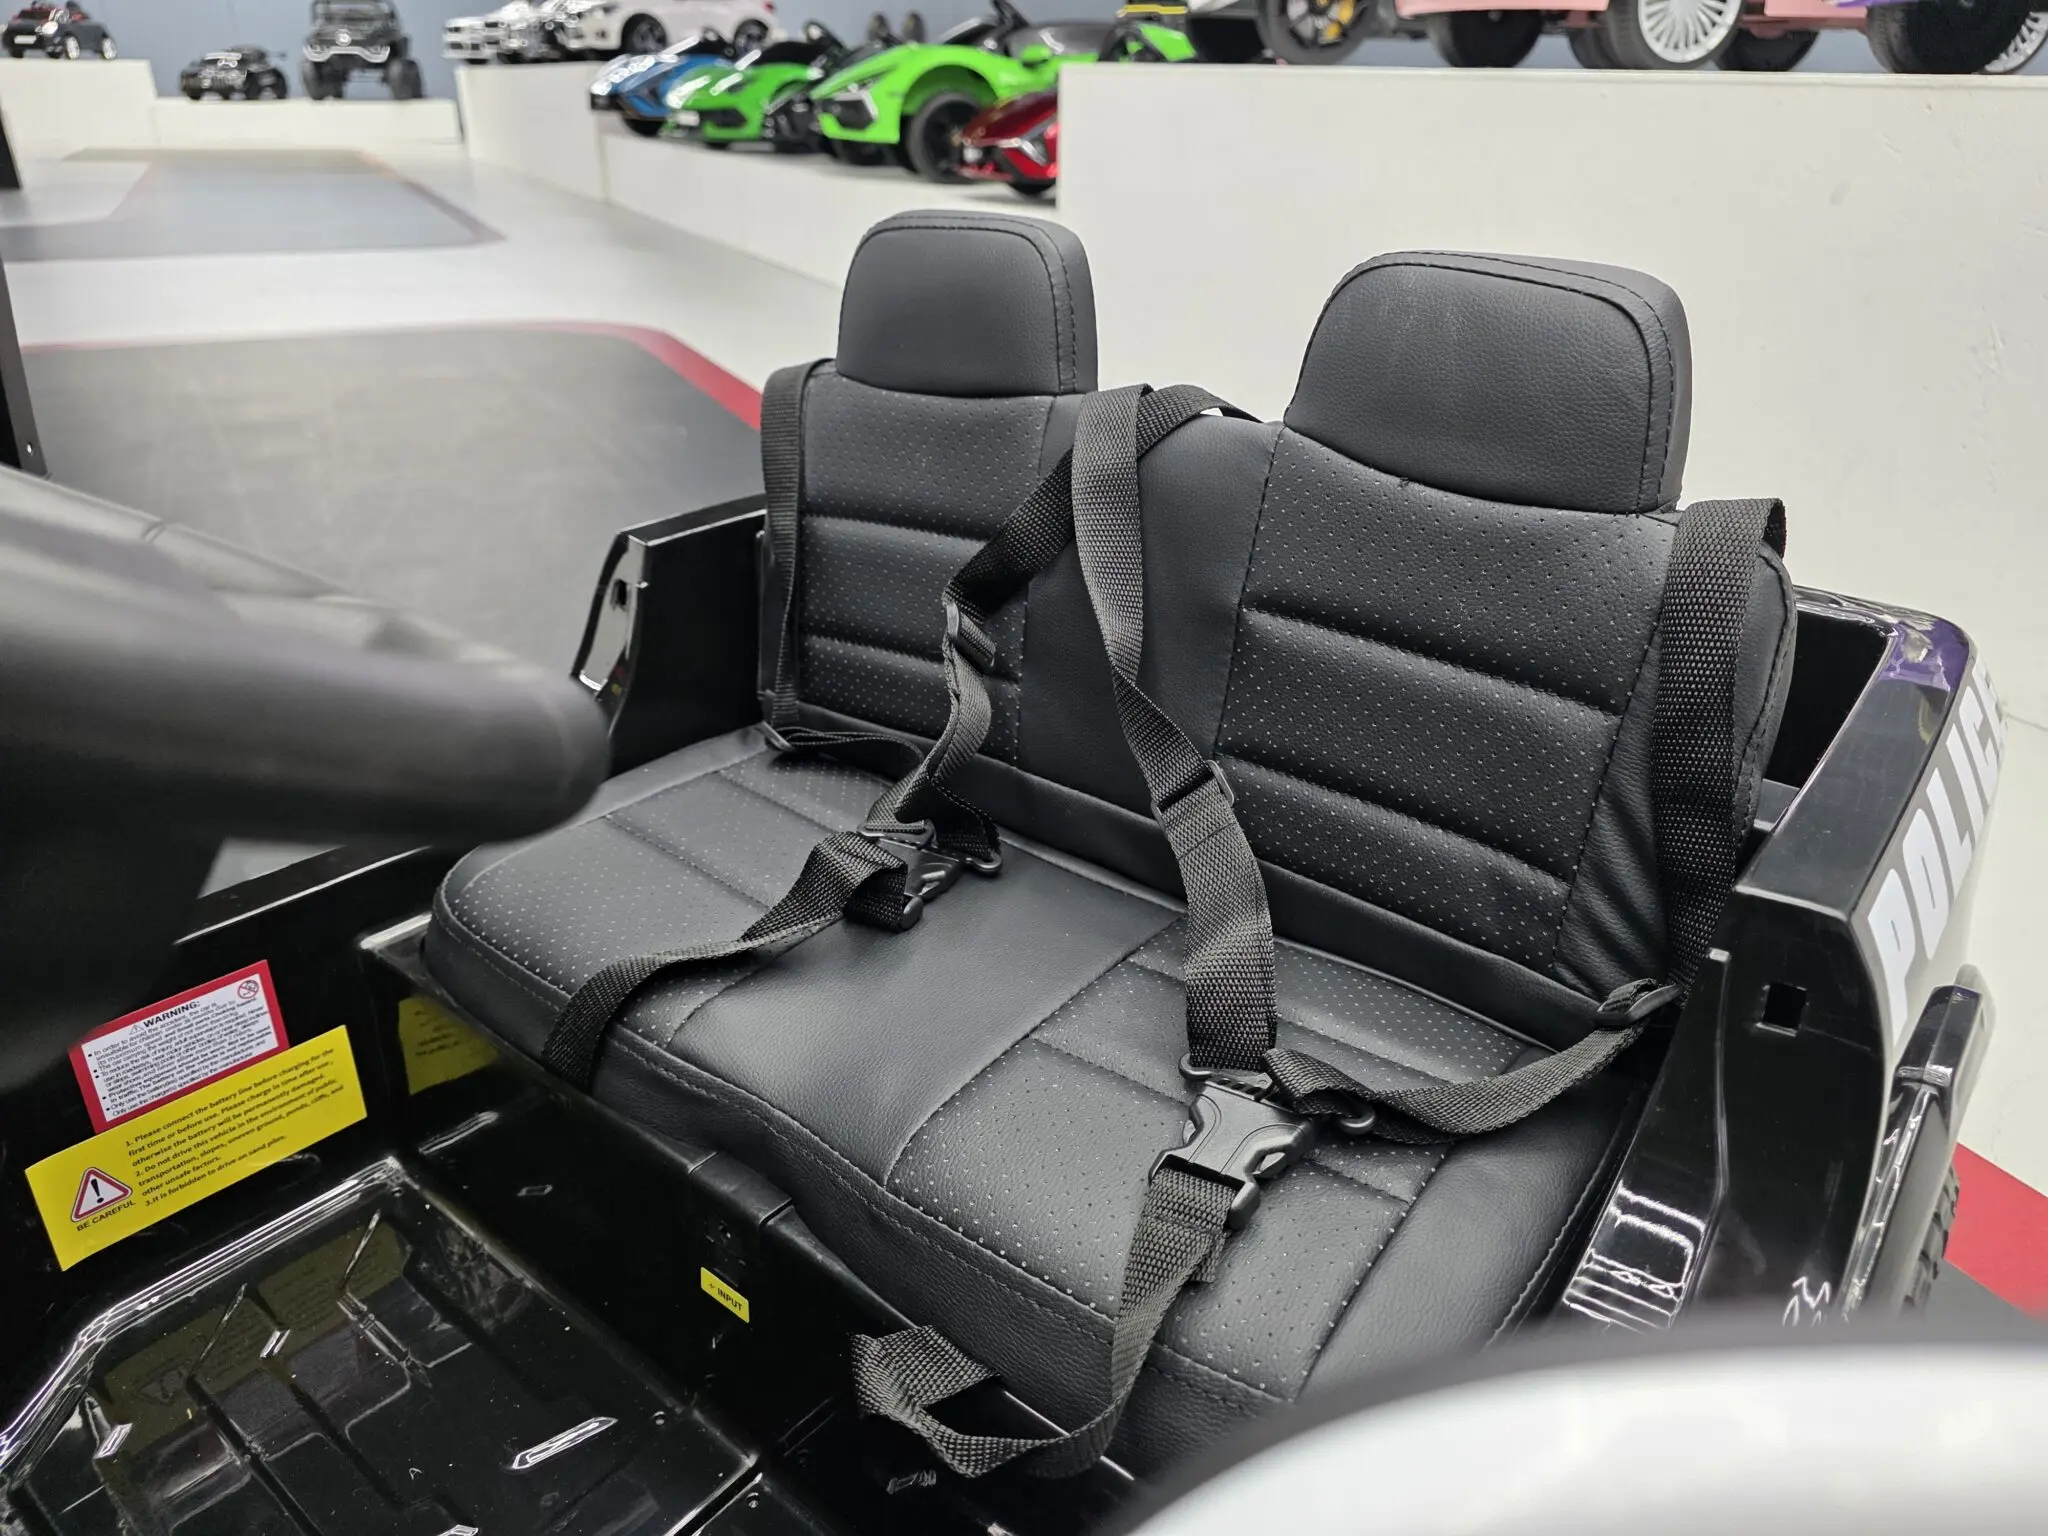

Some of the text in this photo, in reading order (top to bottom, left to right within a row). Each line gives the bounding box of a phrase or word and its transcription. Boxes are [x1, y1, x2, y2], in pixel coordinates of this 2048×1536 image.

[143, 1000, 200, 1028] WARNING:
[128, 1144, 145, 1157] first
[146, 1135, 166, 1148] time
[166, 1131, 176, 1139] or
[176, 1117, 203, 1134] before
[220, 1098, 245, 1114] Please
[246, 1086, 271, 1103] charge
[134, 1126, 161, 1142] Please
[162, 1111, 193, 1130] connect
[194, 1104, 208, 1115] the
[208, 1091, 237, 1109] battery
[253, 1072, 277, 1088] before
[131, 1143, 172, 1167] otherwise
[173, 1137, 186, 1147] the
[187, 1123, 216, 1142] battery
[216, 1116, 231, 1127] will
[232, 1111, 242, 1119] be
[144, 1163, 156, 1173] Do
[156, 1155, 171, 1167] not
[171, 1145, 192, 1160] drive
[193, 1138, 208, 1149] this
[208, 1124, 236, 1142] vehicle
[237, 1120, 245, 1128] in
[245, 1114, 258, 1124] the
[141, 1181, 163, 1196] other
[164, 1168, 191, 1185] unsafe
[159, 1191, 167, 1199] is
[167, 1171, 207, 1195] forbidden
[207, 1167, 216, 1176] to
[216, 1157, 236, 1171] drive
[237, 1153, 247, 1161] on
[76, 1198, 135, 1232] BE CAREFUL
[717, 1287, 742, 1311] INPUT
